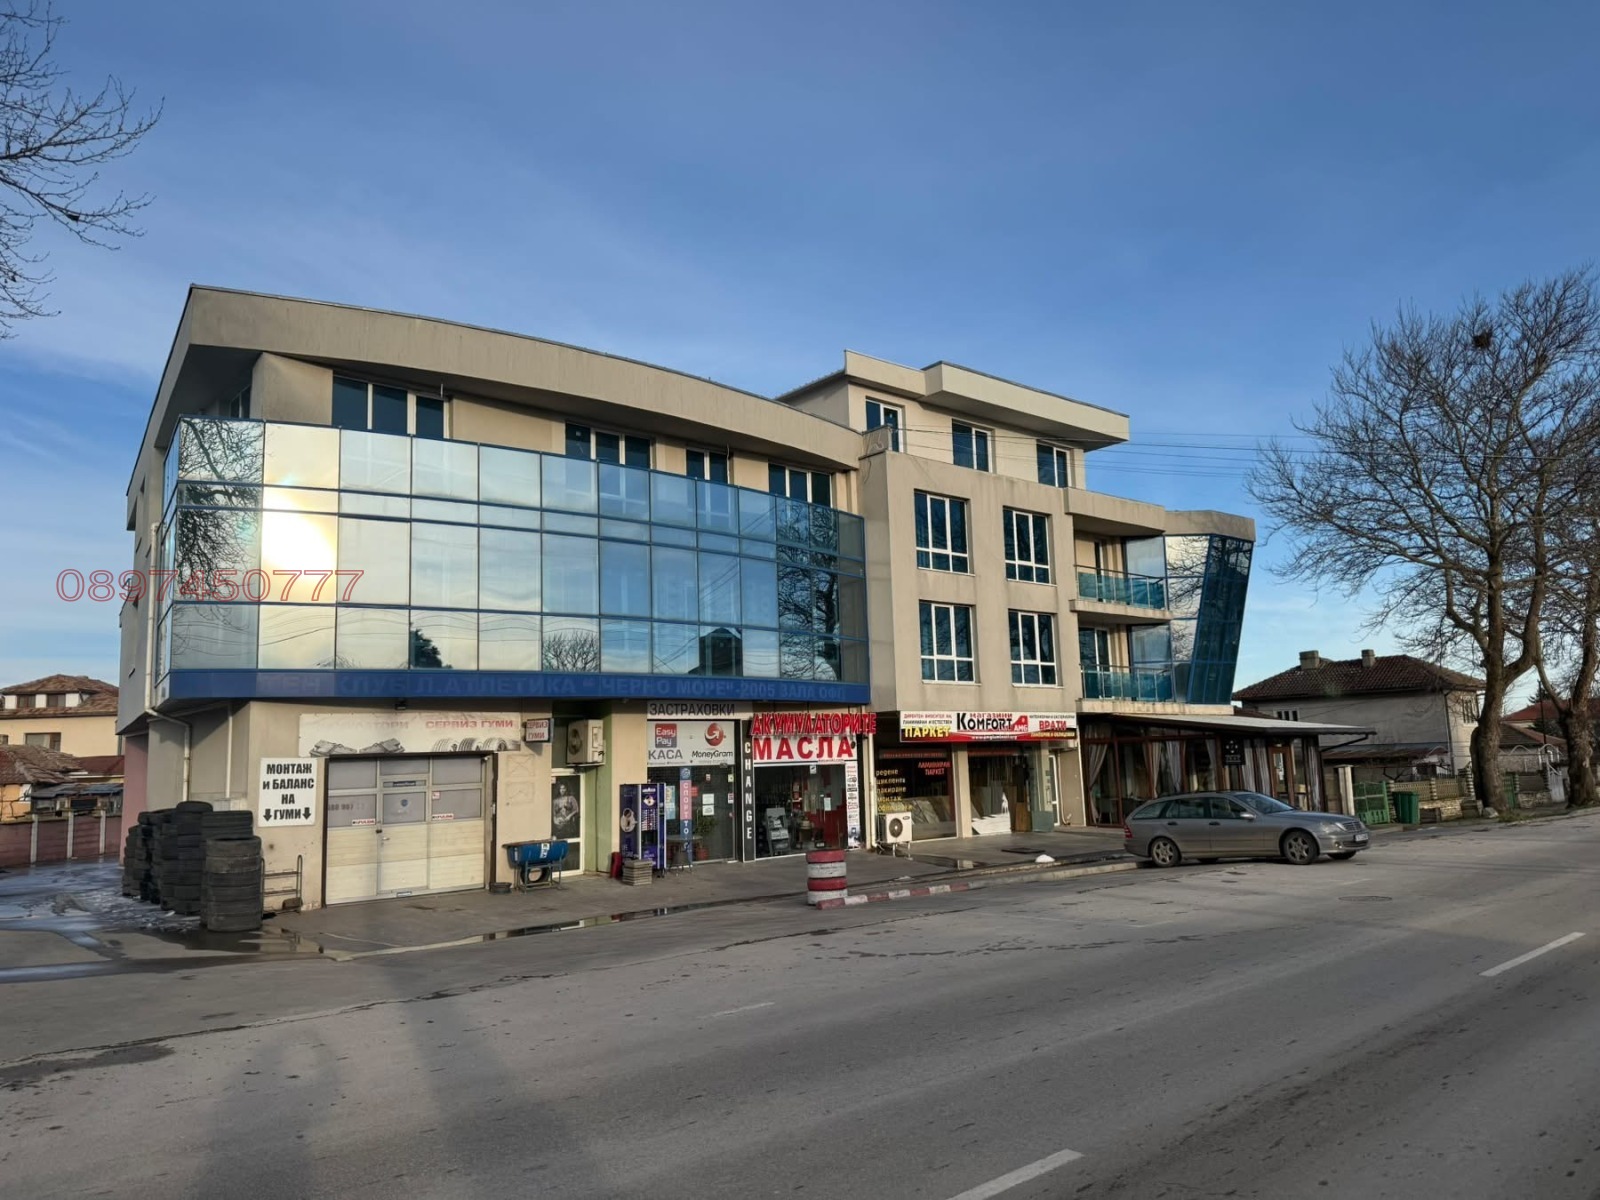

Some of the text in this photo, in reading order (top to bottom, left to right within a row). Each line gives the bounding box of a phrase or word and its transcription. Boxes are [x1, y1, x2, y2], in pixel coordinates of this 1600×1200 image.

[649, 703, 736, 717] ЗАСТРАХОВКИ
[425, 718, 514, 730] СЕРВИЗ ГУМИ
[751, 712, 878, 736] АКУМУЛАТОРИТЕ
[1039, 720, 1067, 732] ВРАТИ
[527, 732, 545, 740] ГУМИ
[656, 727, 676, 739] Easy
[905, 725, 951, 738] ПАРКЕТ
[656, 737, 672, 747] Pay
[648, 749, 683, 760] КАСА
[692, 749, 734, 759] MoneyGram
[754, 737, 854, 761] МАСЛА
[266, 763, 313, 775] МОНТАЖ
[925, 768, 945, 776] ПАРКЕТ
[272, 778, 315, 790] БАЛАНС
[745, 741, 753, 839] CHANGE
[281, 793, 296, 805] НА
[274, 808, 302, 820] ГУМИ
